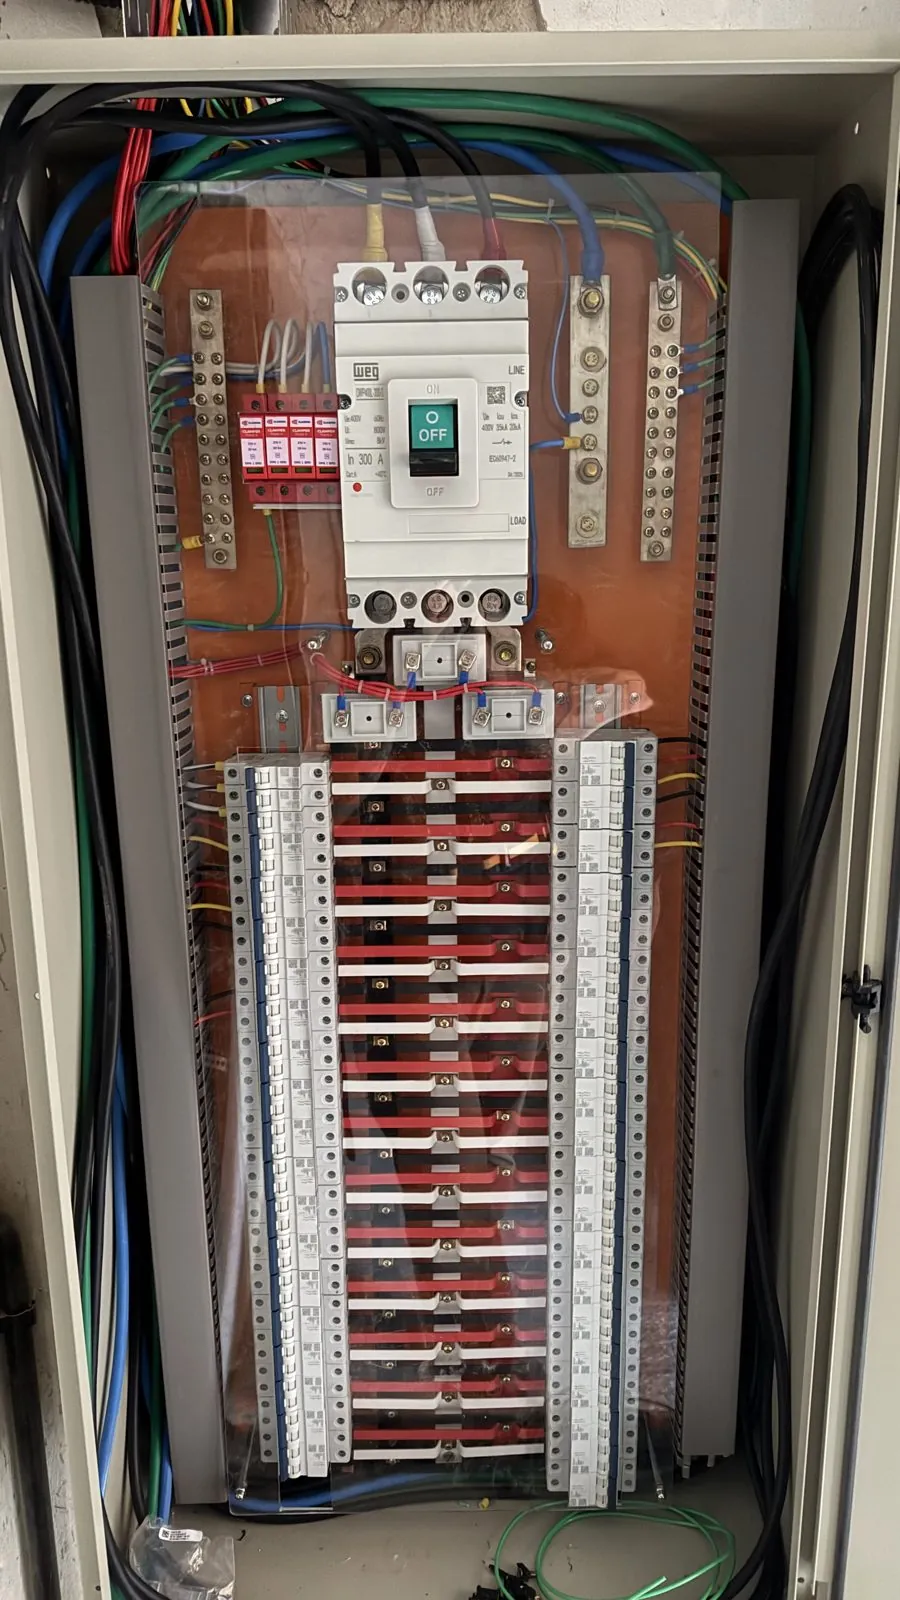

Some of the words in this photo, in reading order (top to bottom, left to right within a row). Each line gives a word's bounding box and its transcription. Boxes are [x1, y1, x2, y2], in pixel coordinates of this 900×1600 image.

[508, 365, 525, 375] LINE
[426, 384, 440, 394] ON
[419, 428, 447, 441] OFF
[359, 453, 372, 465] 300
[378, 453, 384, 465] A
[426, 487, 444, 497] OFF
[510, 516, 527, 525] LOAD
